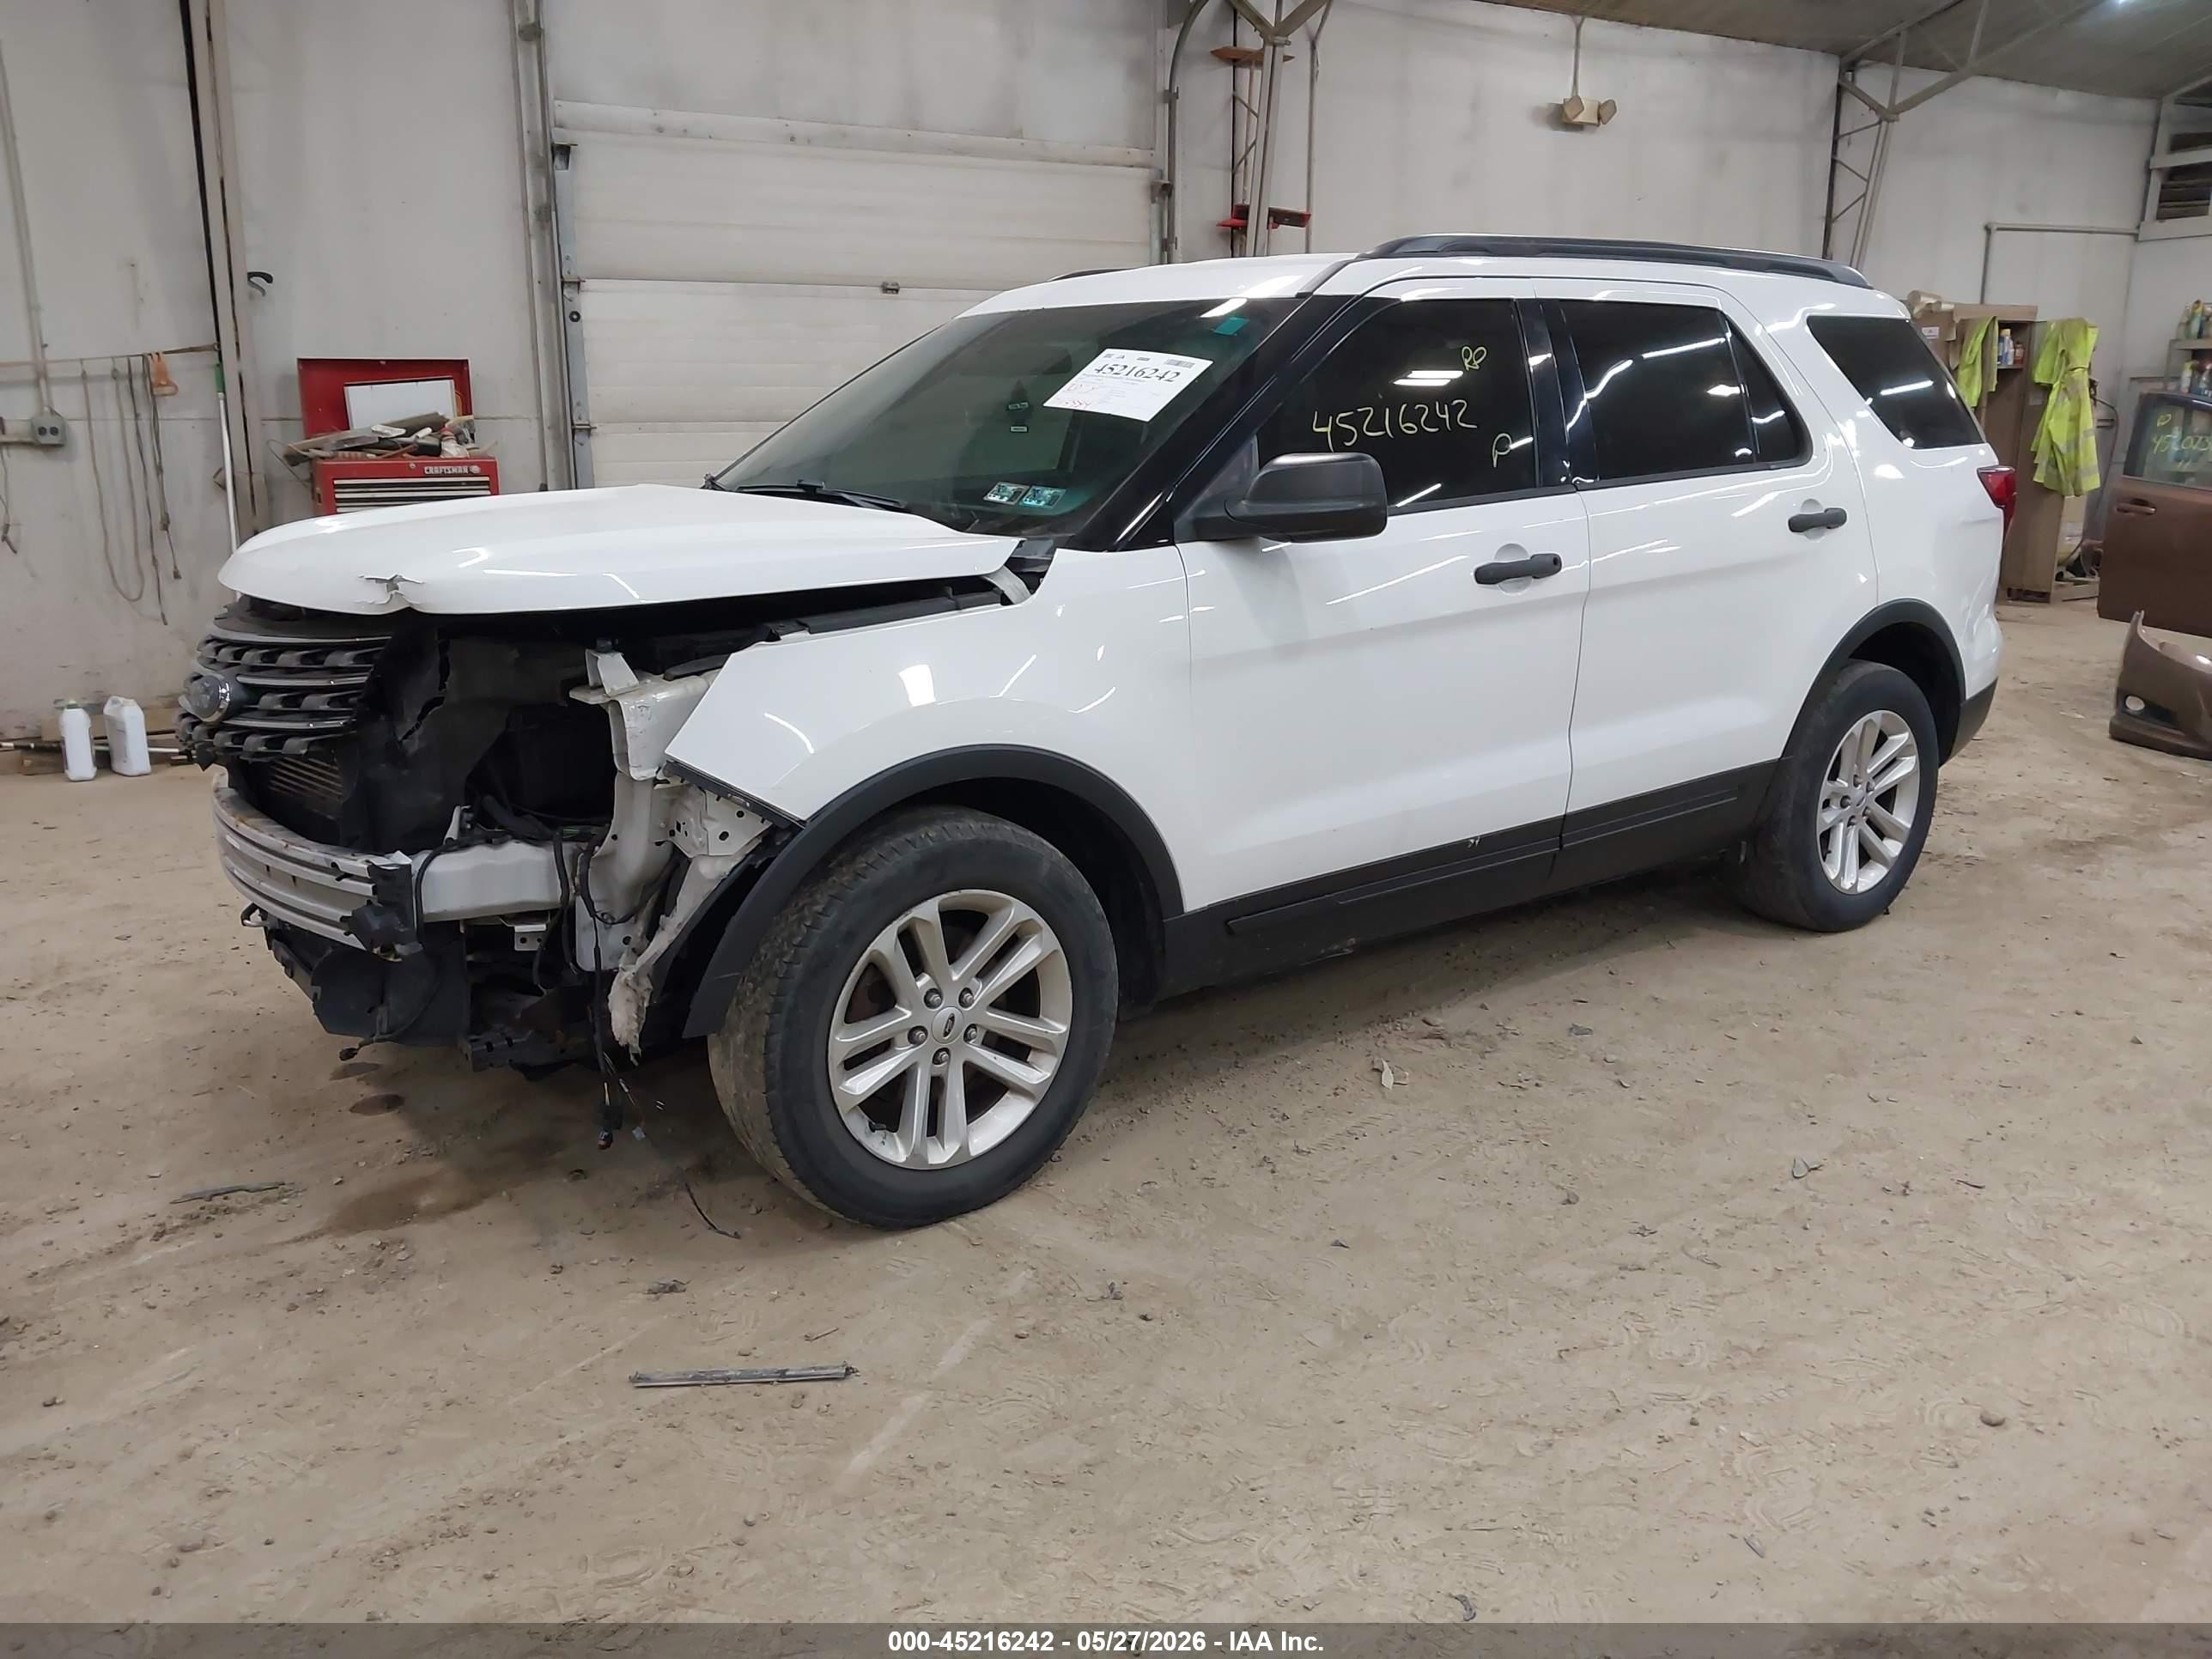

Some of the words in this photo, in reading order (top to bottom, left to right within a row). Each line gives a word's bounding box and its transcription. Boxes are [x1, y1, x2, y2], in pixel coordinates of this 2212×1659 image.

[1094, 362, 1182, 383] 45216242
[1312, 399, 1478, 453] 45216242
[424, 465, 469, 475] CRAFTSMAN
